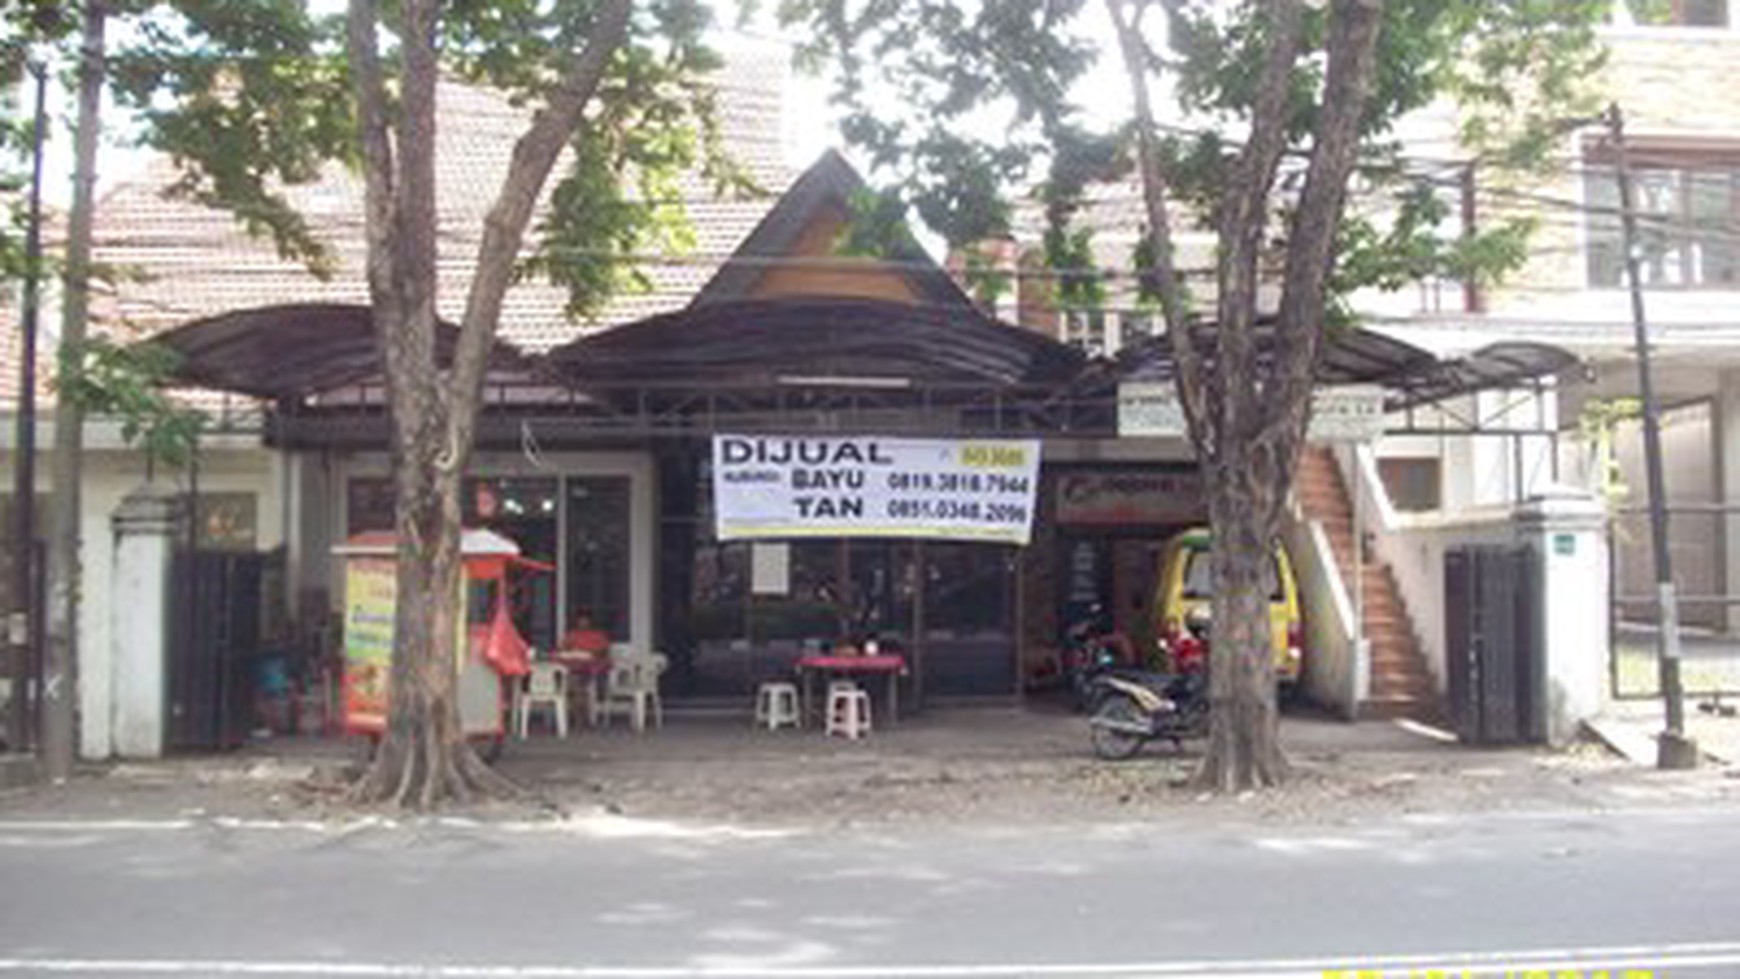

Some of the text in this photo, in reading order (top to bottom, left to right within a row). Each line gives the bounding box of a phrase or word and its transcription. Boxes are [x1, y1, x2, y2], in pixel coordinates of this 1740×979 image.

[721, 439, 893, 466] DIJUAL
[791, 469, 864, 489] BAYU
[793, 498, 863, 518] TAN
